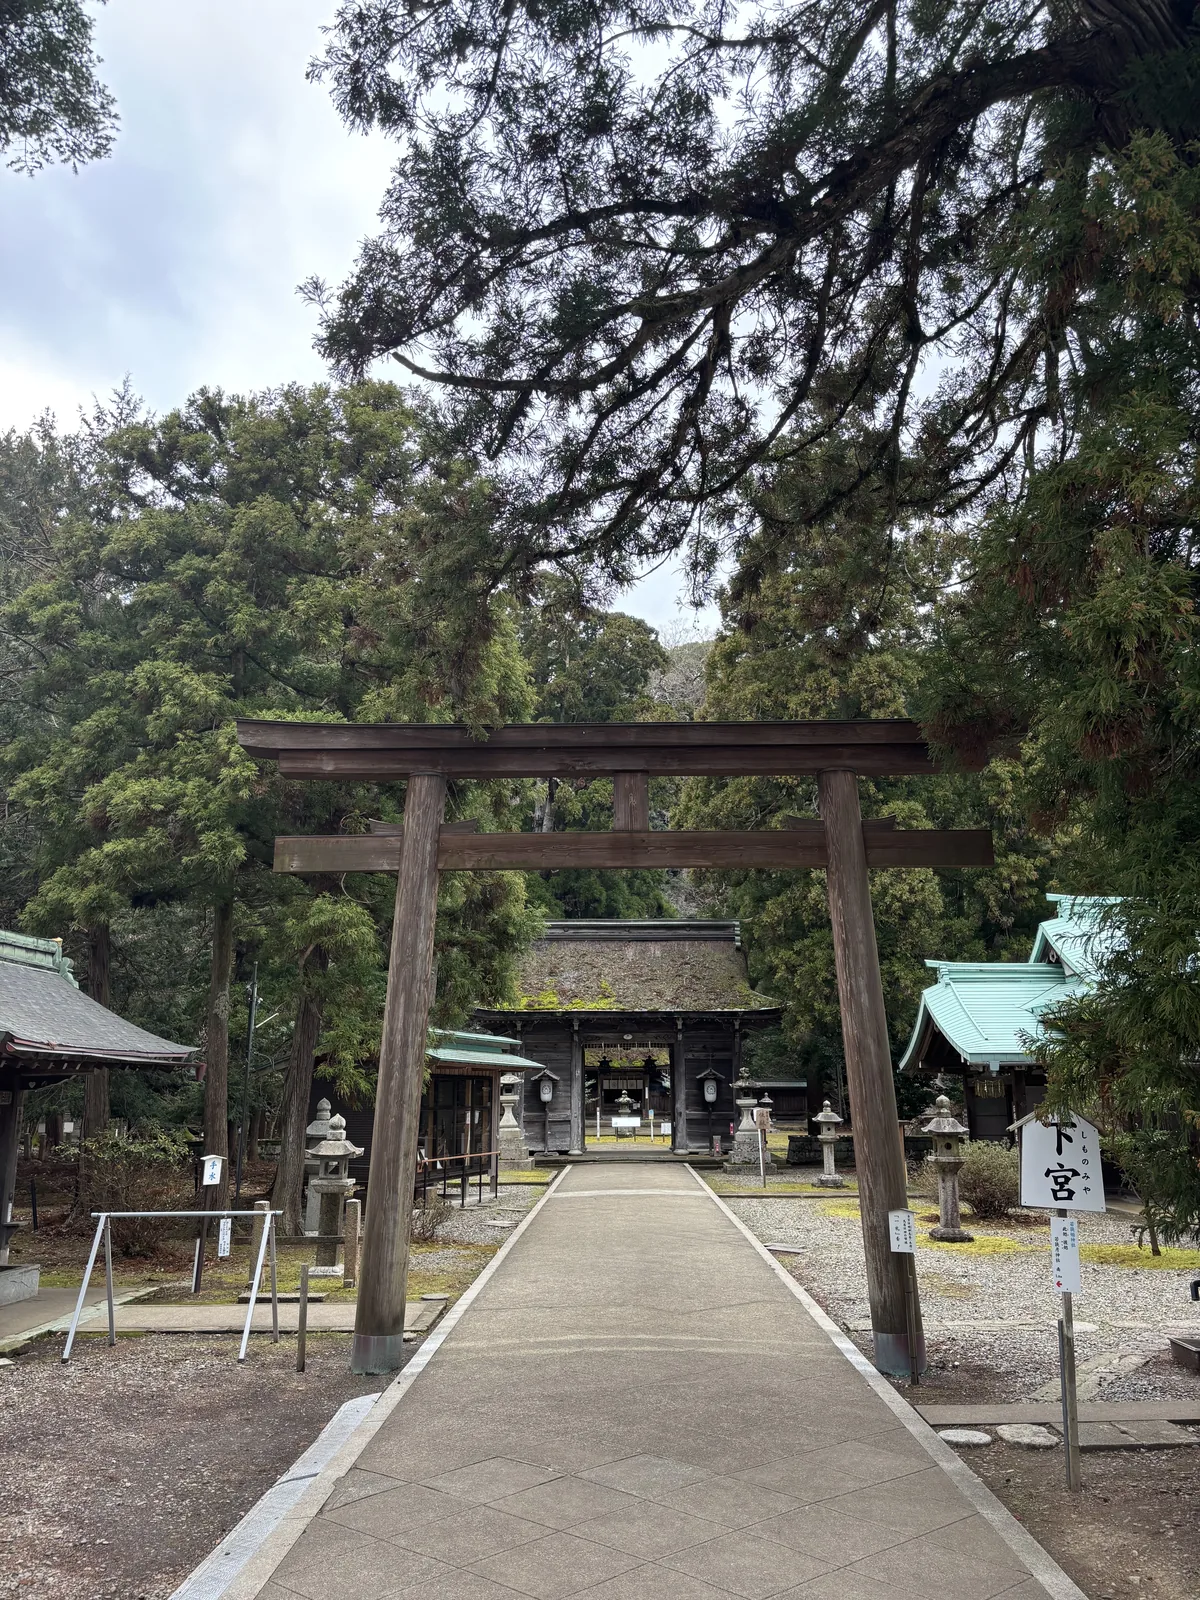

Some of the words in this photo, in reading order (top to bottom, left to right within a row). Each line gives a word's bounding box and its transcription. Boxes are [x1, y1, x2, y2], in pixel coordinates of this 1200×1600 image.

[208, 1160, 218, 1181] 手水
[1041, 1121, 1081, 1202] 下宮
[1081, 1131, 1091, 1195] しものみや
